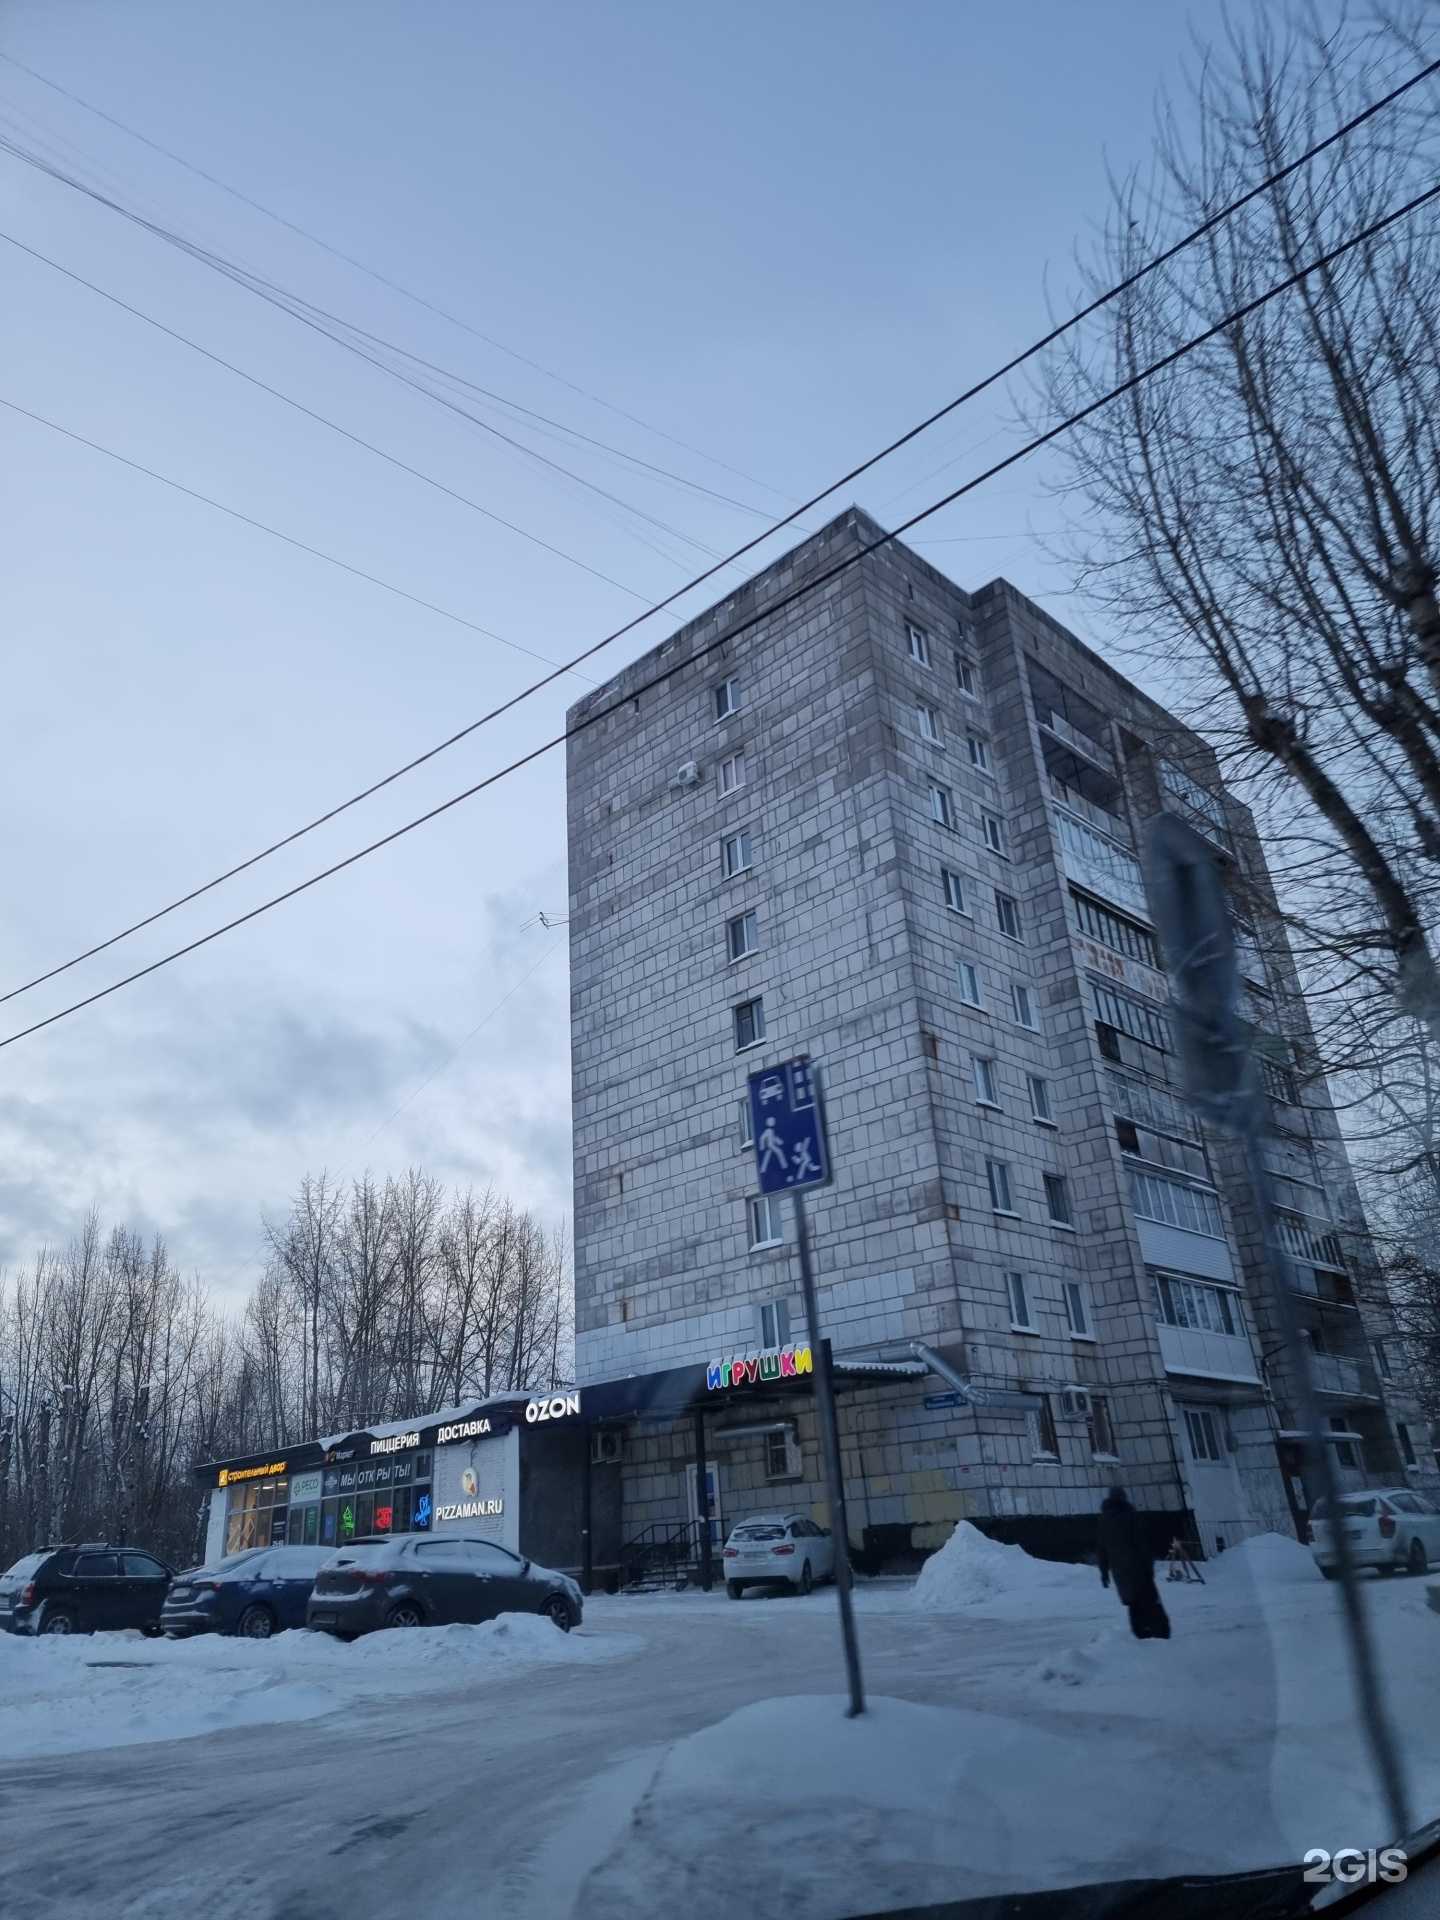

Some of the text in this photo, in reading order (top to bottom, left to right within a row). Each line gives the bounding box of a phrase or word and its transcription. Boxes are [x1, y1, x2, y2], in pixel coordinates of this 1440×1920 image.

[707, 1347, 813, 1390] ИГРУШКИ
[525, 1392, 580, 1423] OZON
[370, 1418, 491, 1454] ПИЦЦЕРИЯ ДОСТАВКА
[435, 1499, 503, 1520] PIZZAMAN.RU
